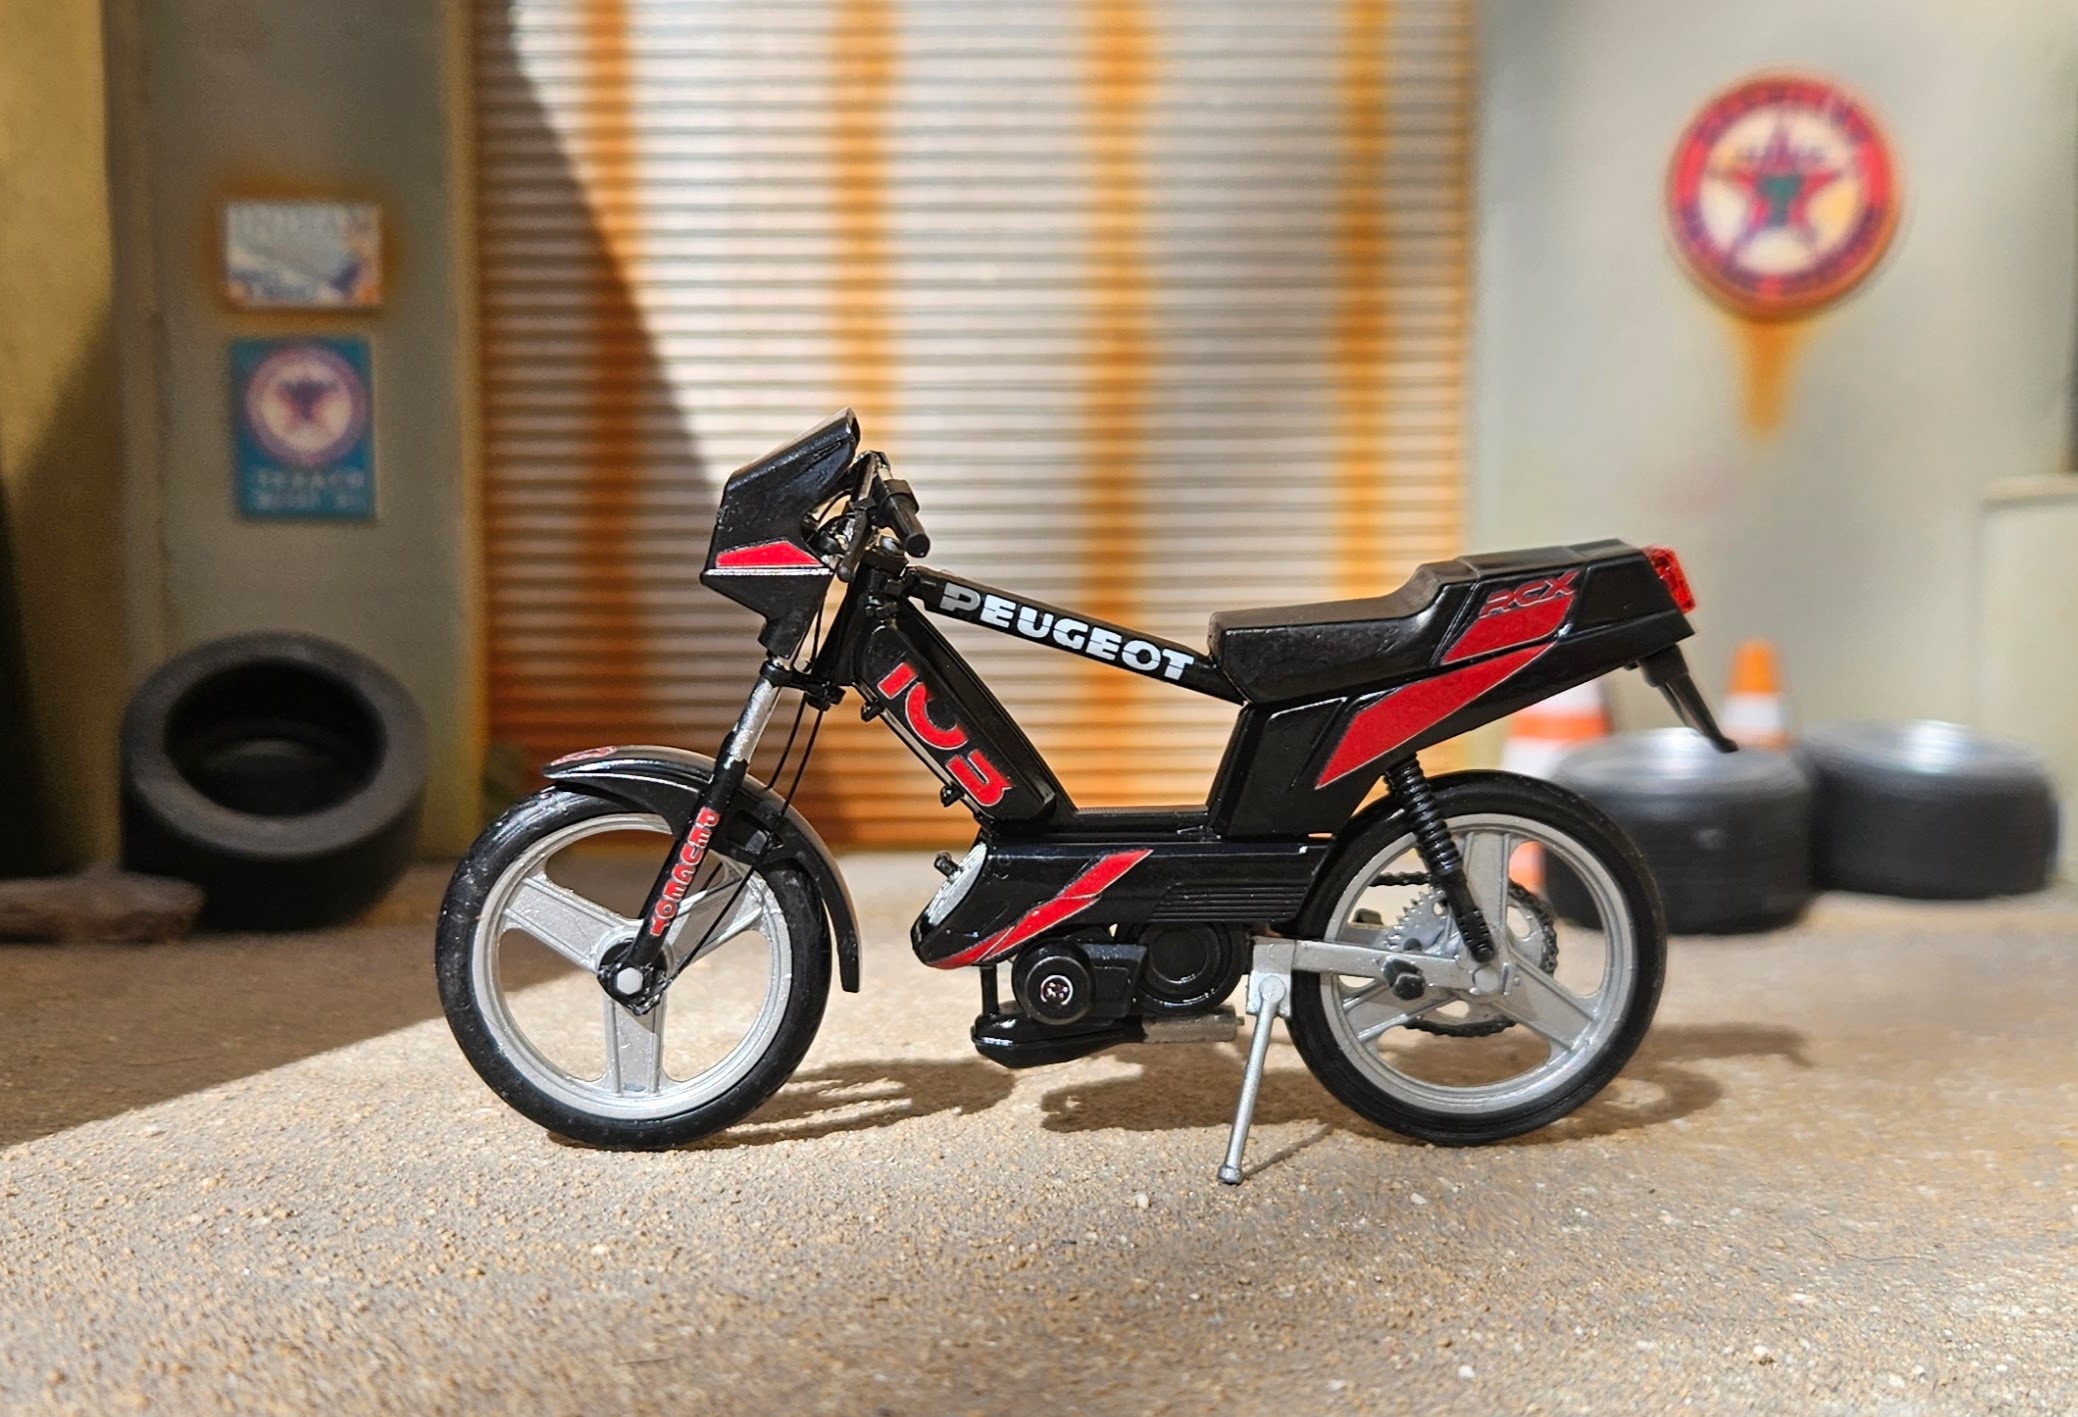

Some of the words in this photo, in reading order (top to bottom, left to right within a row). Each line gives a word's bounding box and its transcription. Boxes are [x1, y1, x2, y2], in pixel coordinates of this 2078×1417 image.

[940, 582, 1194, 680] PEUGEOT
[1479, 569, 1579, 618] RCX
[650, 806, 720, 936] PEUGEOT
